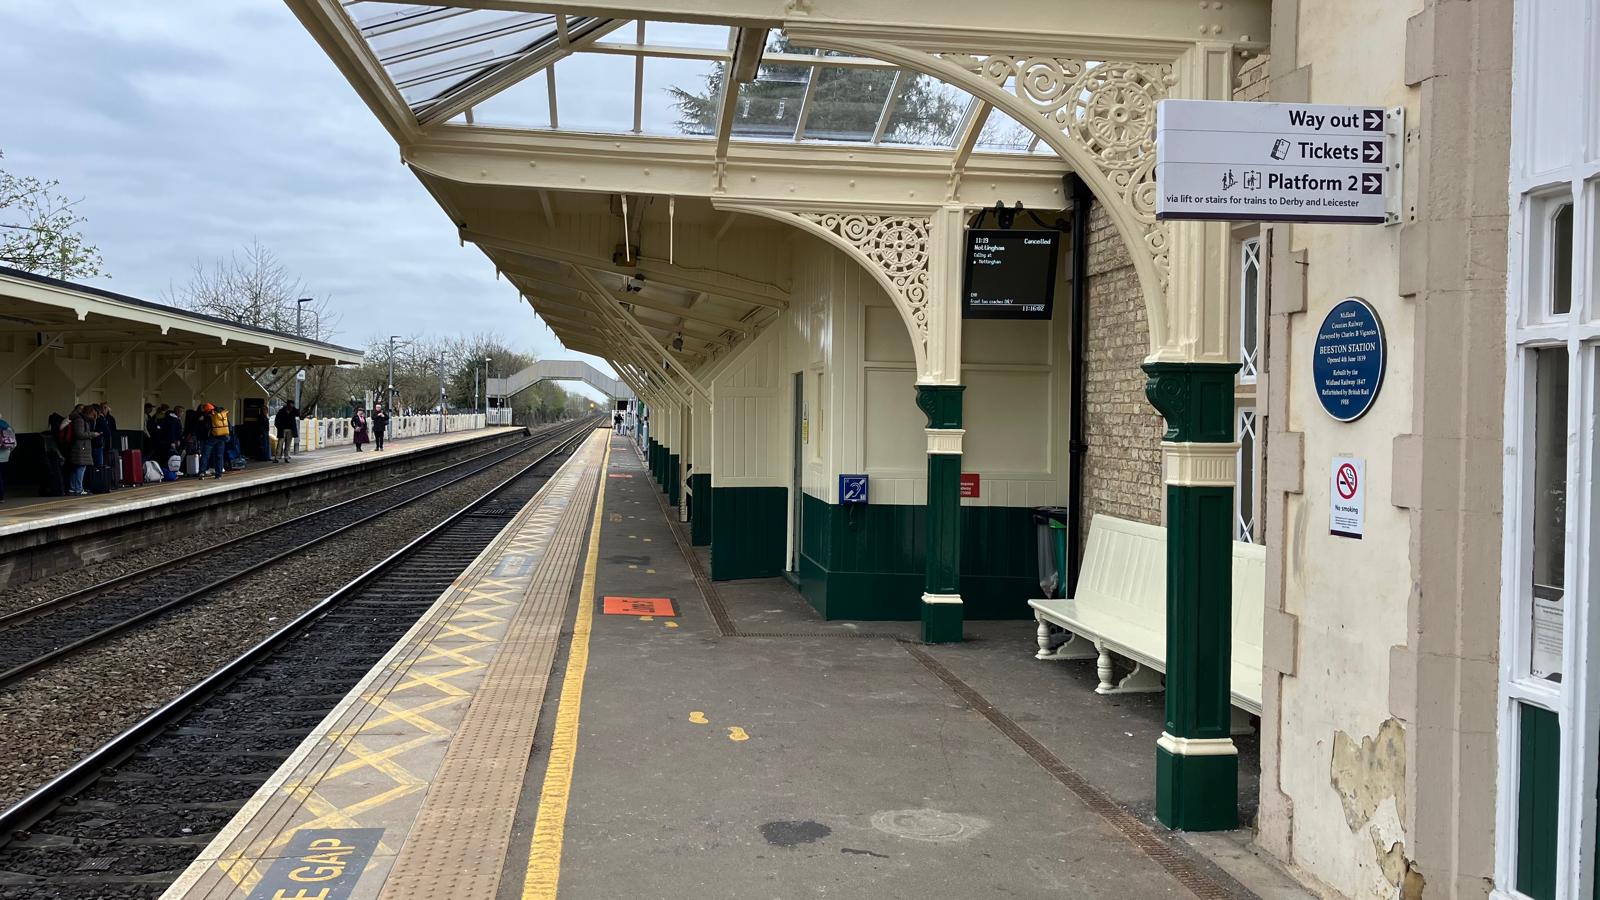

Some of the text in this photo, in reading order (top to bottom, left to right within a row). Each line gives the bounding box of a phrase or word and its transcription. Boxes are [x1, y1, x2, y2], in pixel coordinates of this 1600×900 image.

[1289, 110, 1359, 130] Way out
[1298, 142, 1359, 160] Tickets
[1268, 172, 1358, 191] Platform 2
[1166, 194, 1359, 208] via lift or stairs for trains to Derby and Leicester
[974, 244, 1005, 252] Nottingham
[1320, 342, 1376, 354] BEESTON STATION
[1341, 505, 1358, 514] smoking
[287, 838, 355, 882] GAP
